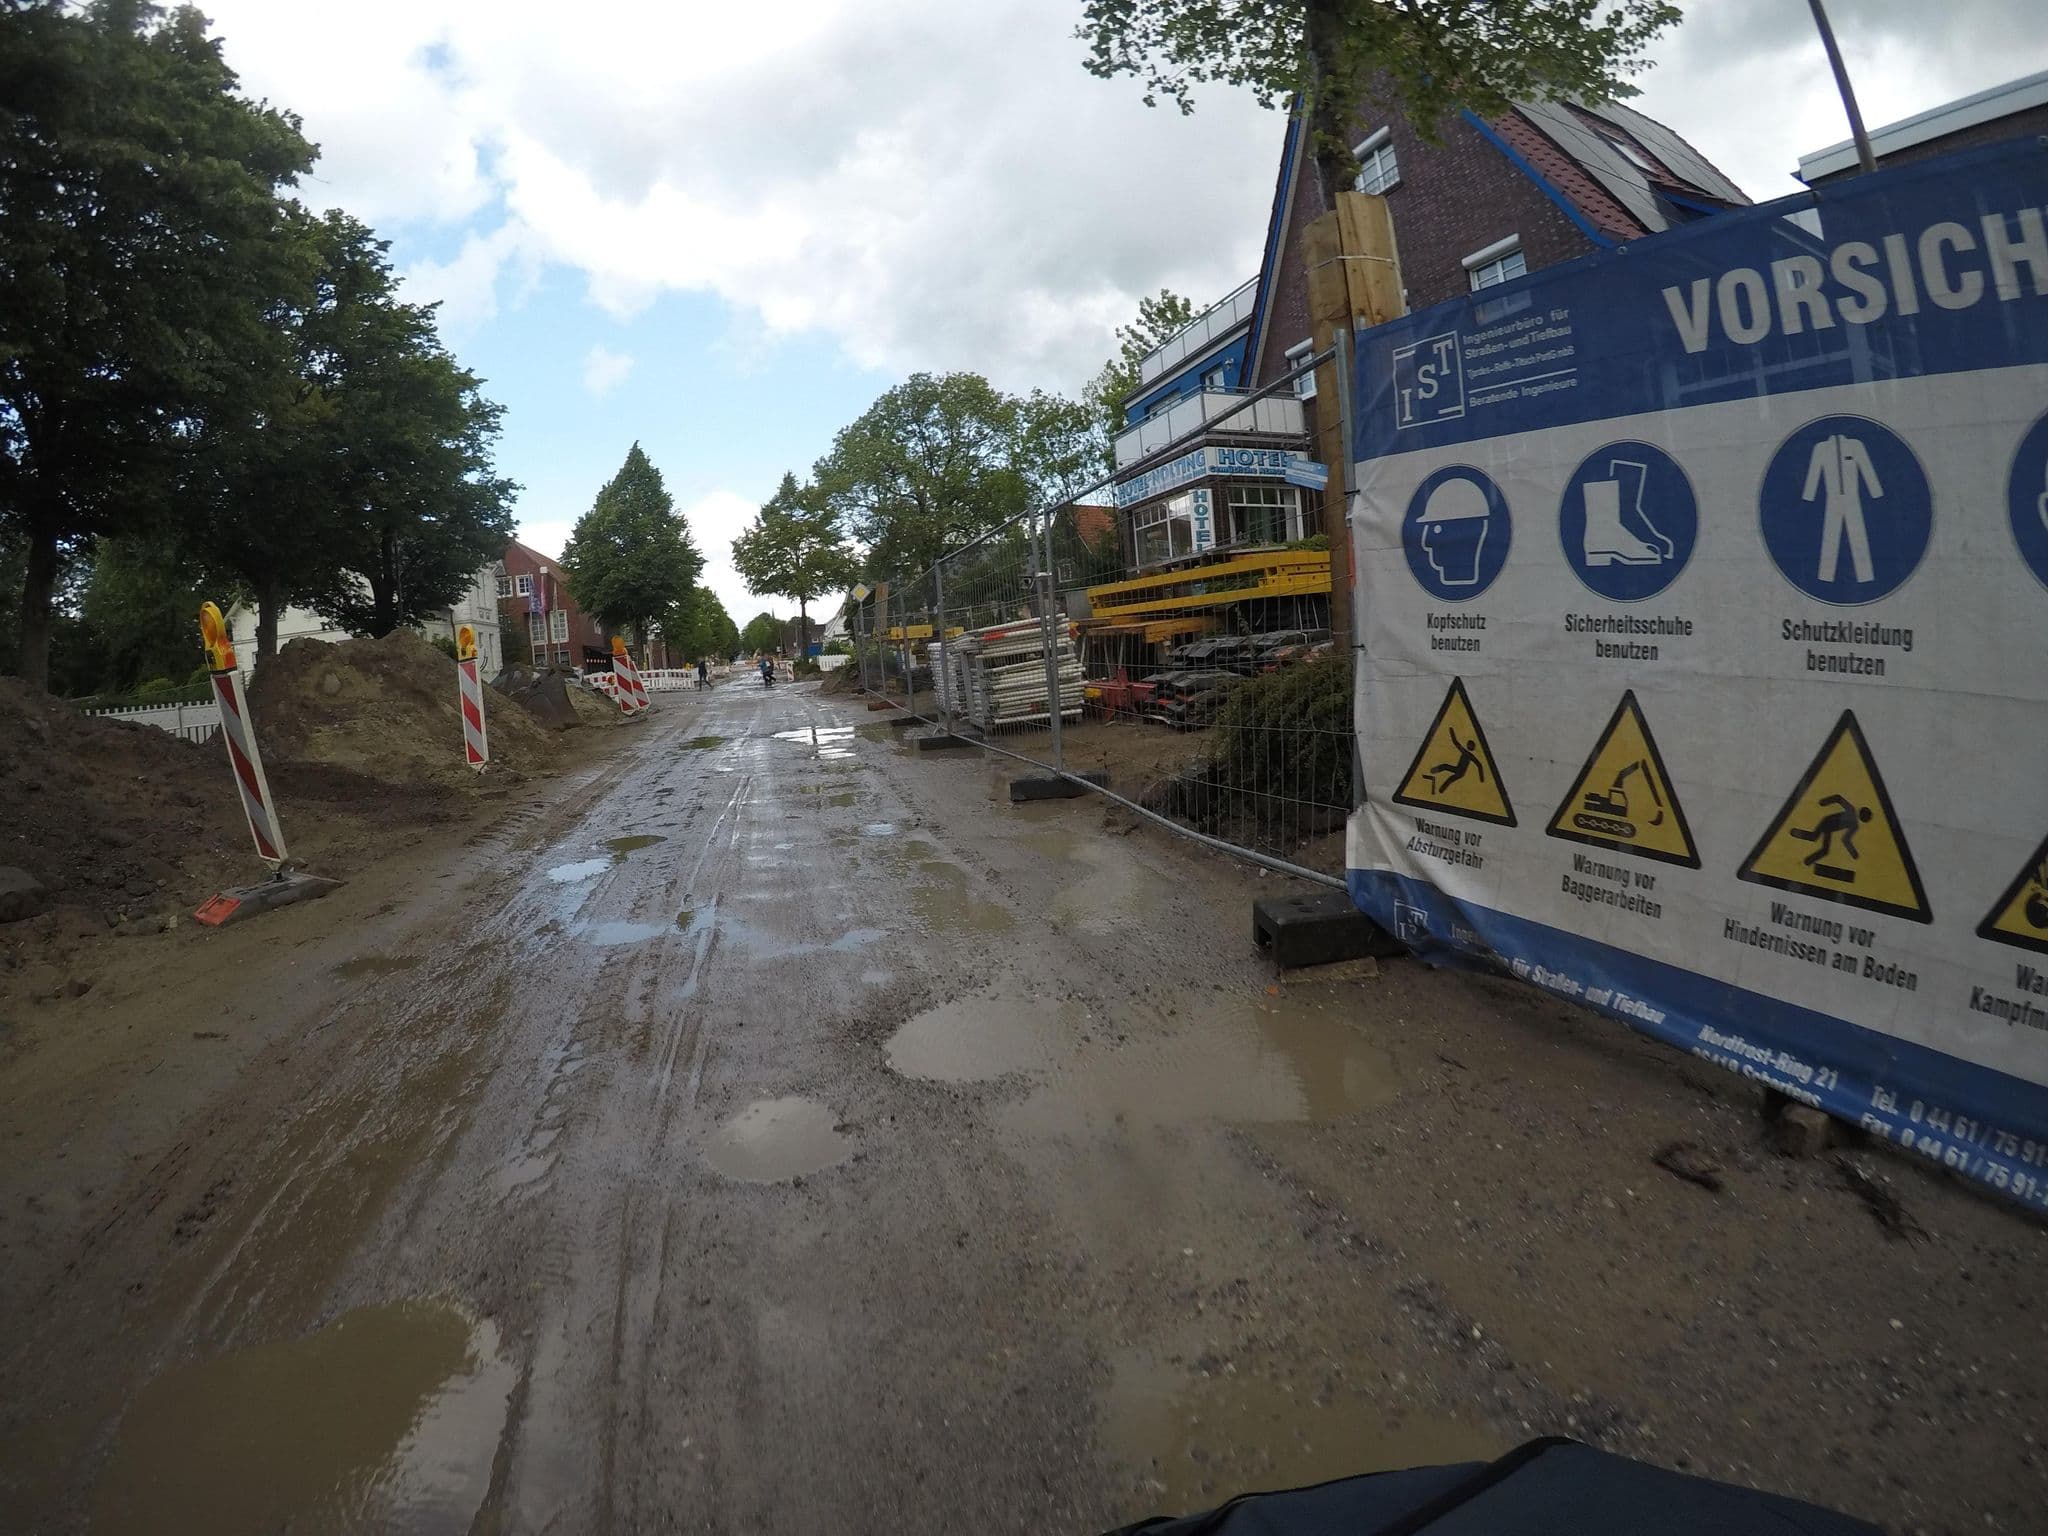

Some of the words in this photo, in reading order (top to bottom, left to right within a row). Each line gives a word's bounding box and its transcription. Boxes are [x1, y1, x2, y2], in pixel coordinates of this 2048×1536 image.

[1663, 206, 2048, 355] VORSICH
[1463, 315, 1544, 345] Ingenieurbüro
[1550, 307, 1570, 322] für
[1465, 341, 1508, 360] Straßen-
[1509, 335, 1530, 349] und
[1530, 325, 1573, 342] Tiefbau
[1469, 389, 1520, 408] Beratende
[1521, 377, 1578, 397] Ingenieure
[1427, 612, 1487, 633] Kopfschutz
[1565, 613, 1693, 637] Sicherheitsschuhe
[1782, 618, 1913, 652] Schutzkleidung
[1431, 634, 1481, 652] benutzen
[1596, 639, 1659, 661] benutzen
[1807, 649, 1886, 676] benutzen
[1415, 817, 1461, 847] Warnung
[1464, 832, 1482, 847] vor
[1406, 835, 1484, 870] Absturzgefahr
[1573, 853, 1630, 886] Warnung
[1634, 870, 1657, 891] vor
[1561, 874, 1662, 919] Baggerarbeiten
[1770, 901, 1844, 944] Warnung
[1848, 924, 1876, 948] vor
[1723, 917, 1828, 966] Hindernissen
[1832, 951, 1858, 975] am
[1862, 955, 1919, 991] Boden
[1814, 1066, 1840, 1092] 21
[2021, 1140, 2048, 1168] 91
